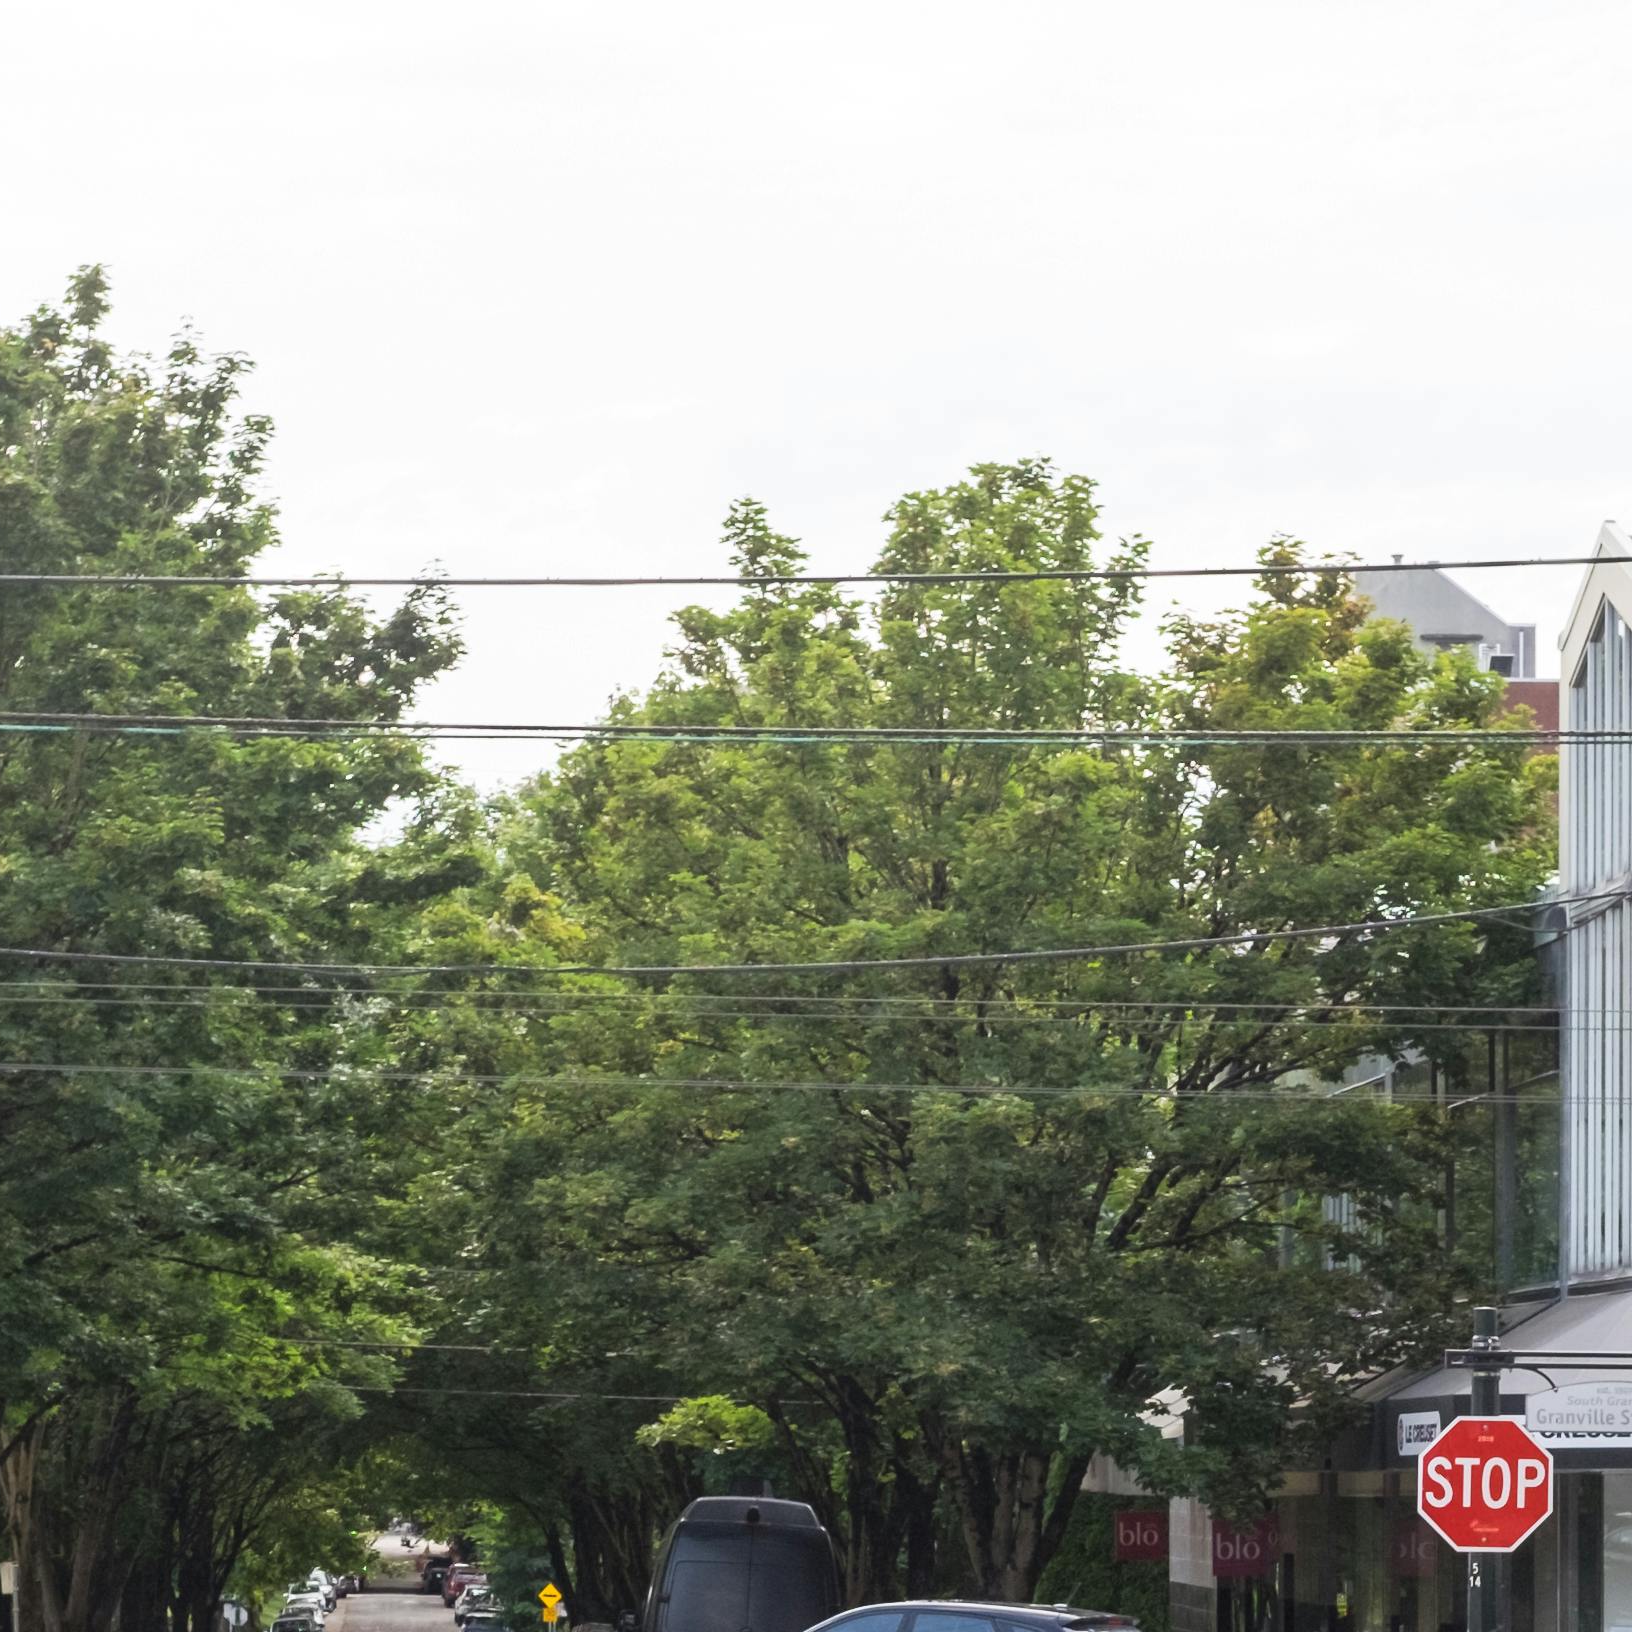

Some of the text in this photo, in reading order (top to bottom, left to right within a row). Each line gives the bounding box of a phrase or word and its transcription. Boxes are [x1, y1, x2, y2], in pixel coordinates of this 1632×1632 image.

[1567, 1396, 1602, 1407] South
[1536, 1408, 1615, 1426] Granville
[1425, 1456, 1546, 1510] STOP
[1472, 1563, 1479, 1575] 5
[1469, 1576, 1481, 1588] 14
